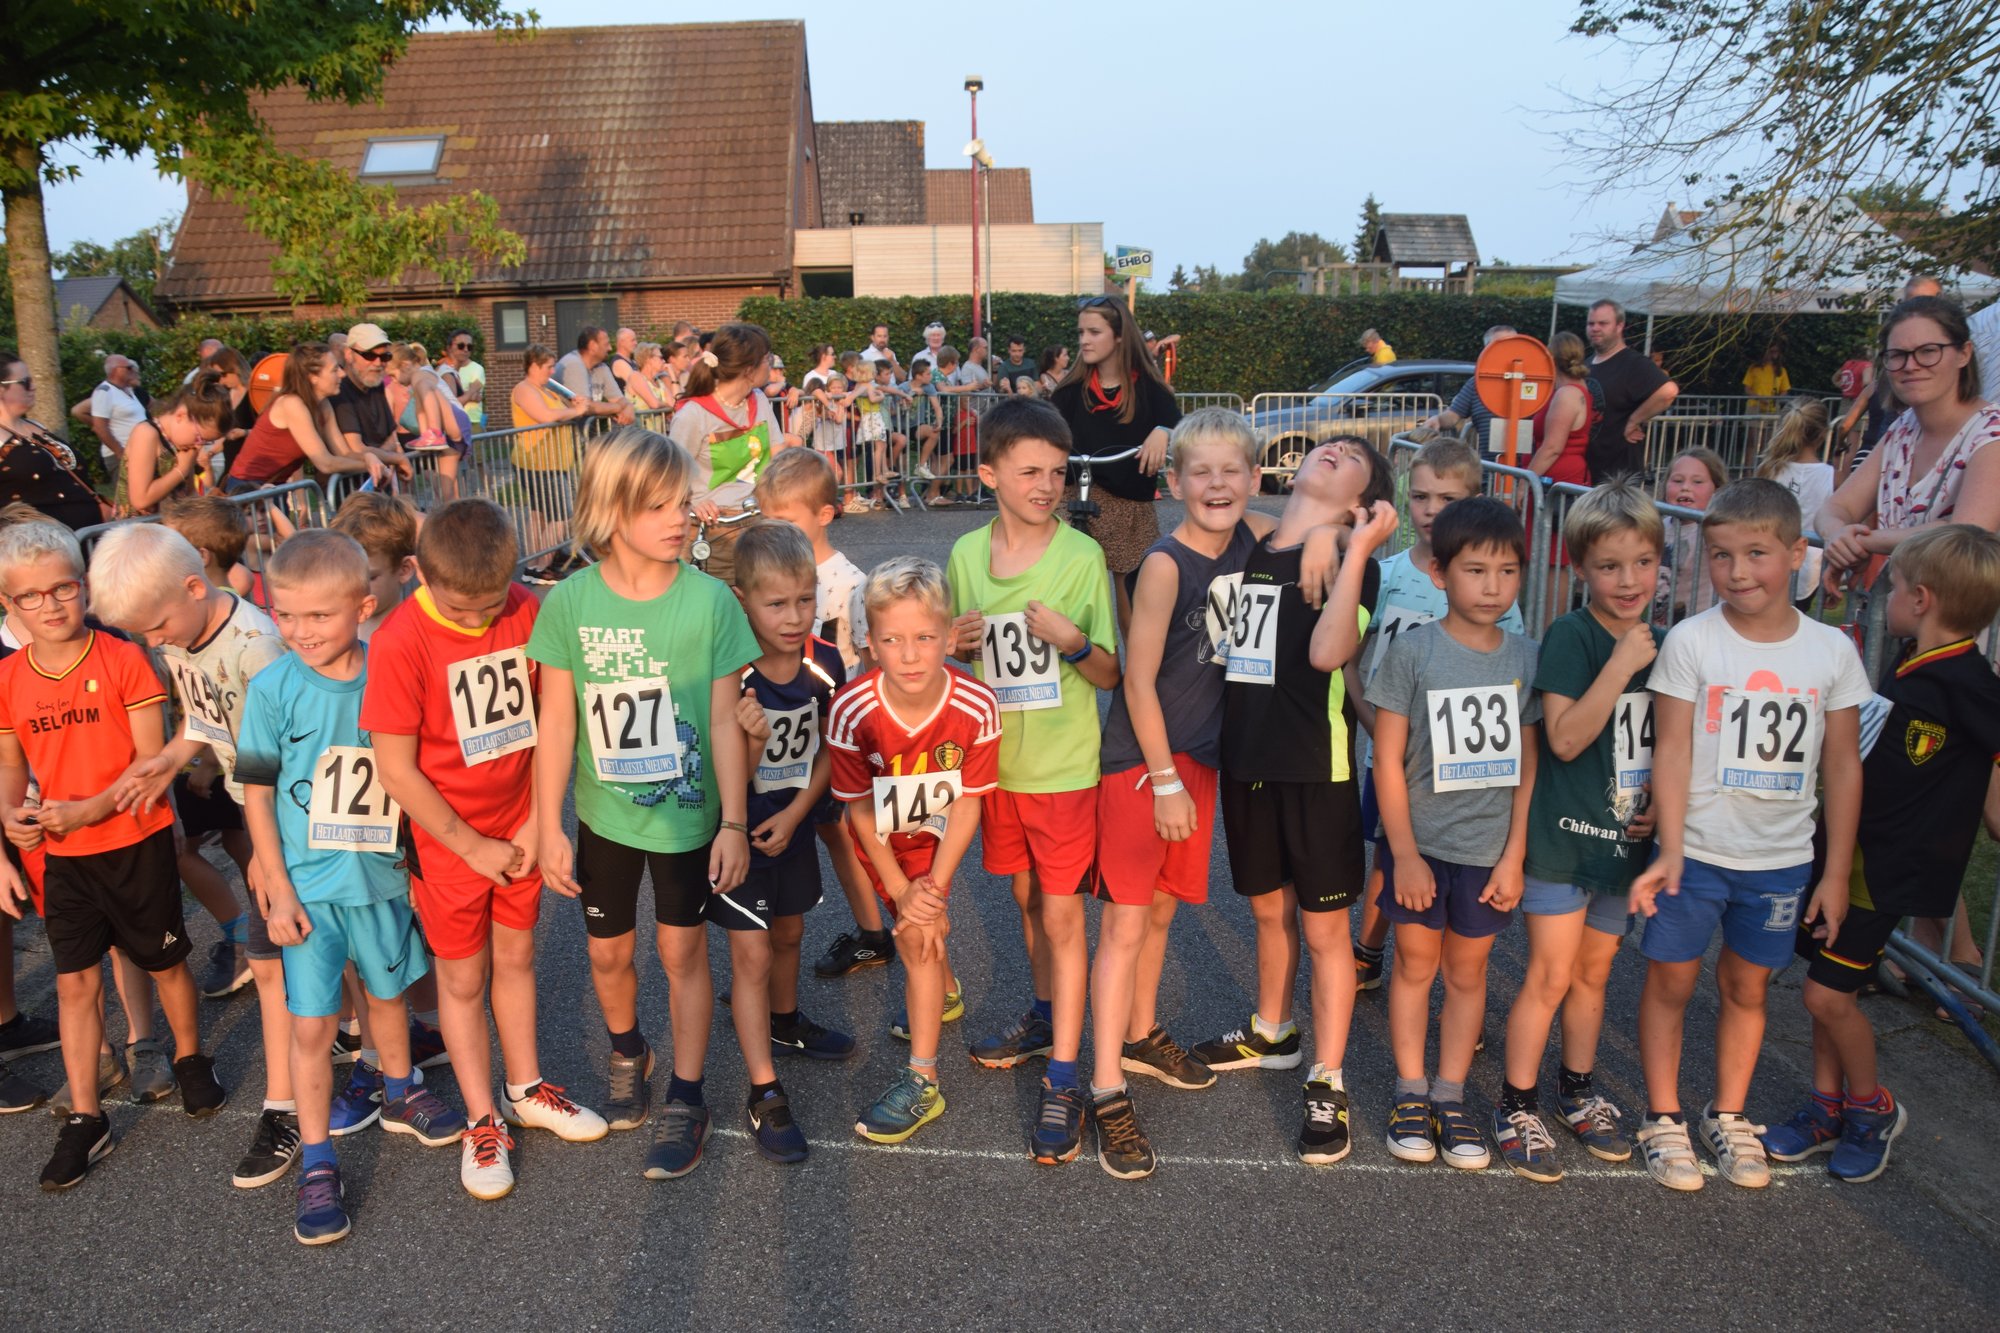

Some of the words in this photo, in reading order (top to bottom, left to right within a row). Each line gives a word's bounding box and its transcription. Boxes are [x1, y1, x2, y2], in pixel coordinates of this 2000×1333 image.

[1118, 254, 1151, 268] EHBO
[1208, 582, 1238, 632] 14
[1234, 592, 1276, 650] 37
[578, 626, 645, 643] START
[985, 621, 1051, 678] 139
[1244, 660, 1269, 675] NIEUWS
[177, 663, 223, 724] 145
[455, 657, 525, 729] 125
[1003, 688, 1028, 702] LAATSTE
[1028, 685, 1056, 700] NIEUWS
[592, 687, 663, 750] 127
[1437, 693, 1511, 755] 133
[1620, 700, 1656, 761] 14
[1731, 698, 1808, 763] 132
[1910, 719, 1946, 733] BELGIUM
[464, 738, 481, 755] HET
[480, 730, 508, 751] LAATSTE
[507, 723, 531, 743] NIEUWS
[766, 710, 813, 763] 35
[601, 758, 616, 773] HET
[615, 759, 644, 775] LAATSTE
[643, 756, 674, 773] NIEUWS
[1442, 765, 1457, 779] HET
[1456, 763, 1487, 778] LAATSTE
[1486, 761, 1513, 776] NIEUWS
[1622, 771, 1635, 787] HET
[1727, 769, 1744, 785] HET
[1743, 770, 1777, 788] LAATSTE
[1777, 772, 1801, 789] NIEUWS
[883, 780, 955, 832] 142
[316, 824, 333, 840] HET
[332, 825, 363, 842] LAATSTE
[362, 827, 389, 843] NIEUWS
[1558, 816, 1618, 841] Chitwan
[1319, 892, 1347, 903] KIPSTA
